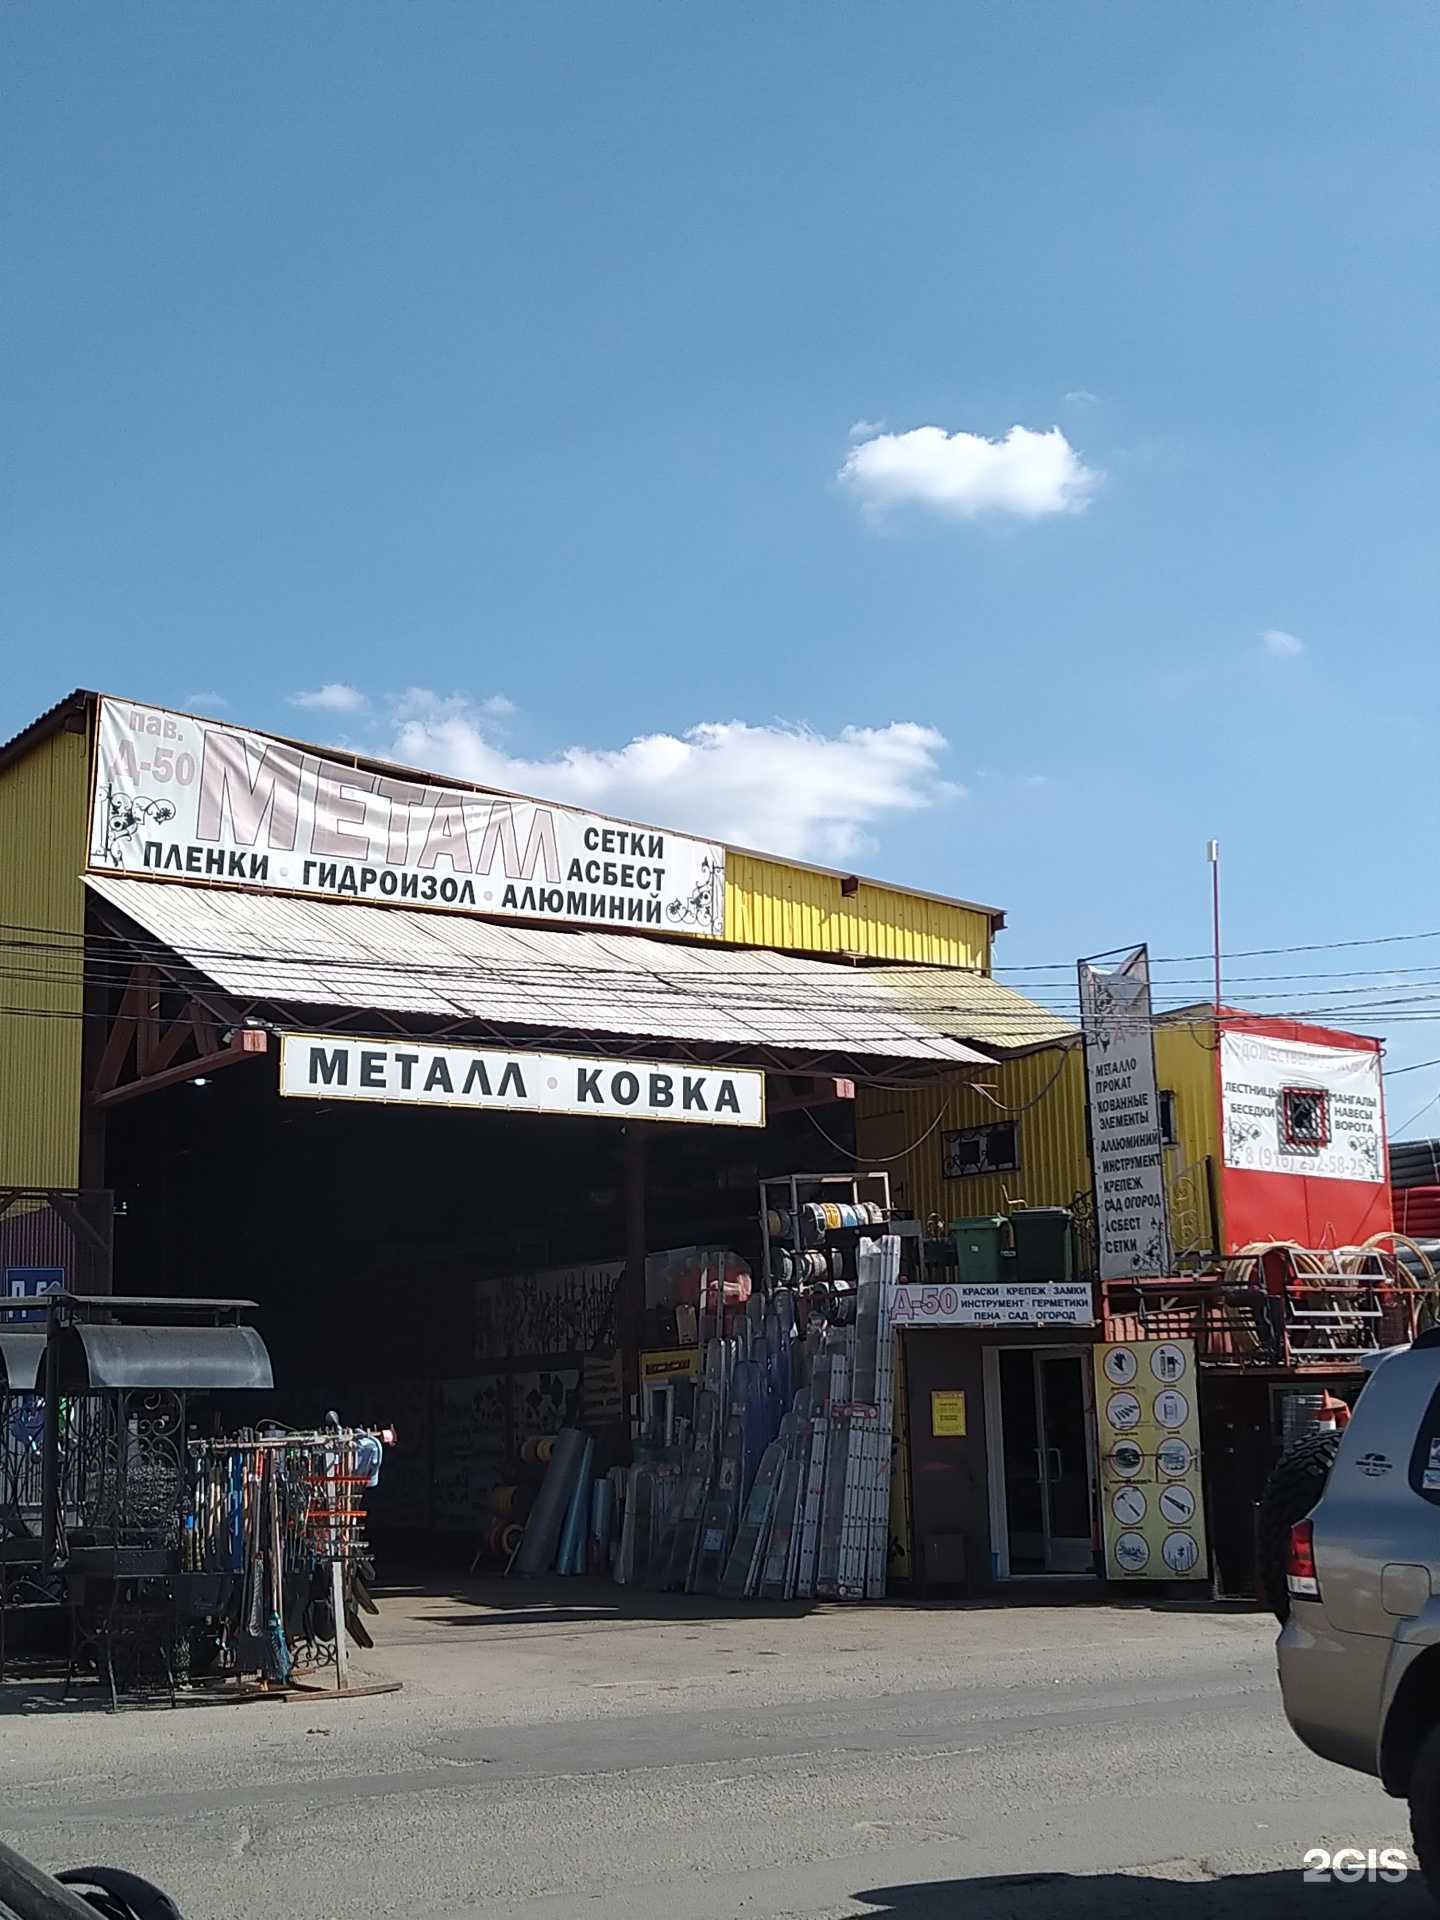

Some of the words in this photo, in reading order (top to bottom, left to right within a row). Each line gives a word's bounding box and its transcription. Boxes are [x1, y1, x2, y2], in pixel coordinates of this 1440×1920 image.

[129, 710, 184, 742] пав.
[584, 826, 664, 860] СЕТКИ
[143, 841, 269, 880] ПЛЕНКИ
[303, 861, 475, 906] ГИДРОИЗОЛ
[502, 884, 662, 924] АЛЮМИНИЙ
[567, 858, 665, 892] АСБЕСТ
[1095, 1057, 1137, 1077] МЕТАЛЛО
[309, 1047, 527, 1098] МЕТАЛЛ
[577, 1067, 742, 1114] КОВКА
[1095, 1075, 1132, 1094] ПРОКАТ
[1097, 1092, 1149, 1113] КОВАННЫЕ
[1231, 1103, 1274, 1118] БЕСЕДКИ
[1099, 1110, 1150, 1130] ЭЛЕМЕНТЫ
[1335, 1106, 1372, 1121] НАВЕСЫ
[1335, 1119, 1374, 1134] ВОРОТА
[1101, 1153, 1161, 1173] ИНСТРУМЕНТ
[1103, 1176, 1144, 1193] КРЕПЕЖ
[1104, 1197, 1123, 1212] САД
[1124, 1193, 1161, 1210] ОГОРОД
[1105, 1238, 1137, 1254] СЕТКИ
[962, 1287, 999, 1296] КРАСКИ
[1006, 1287, 1046, 1296] КРЕПЕЖ
[1053, 1286, 1087, 1296] ЗАМКИ
[889, 1287, 958, 1321] Д-50
[961, 1298, 1024, 1308] ИНСТРУМЕНТ
[1031, 1298, 1089, 1308] ГЕРМЕТИКИ
[974, 1311, 1001, 1321] ПЕНА
[1008, 1311, 1029, 1322] САД
[1036, 1311, 1077, 1321] ОГОРОД
